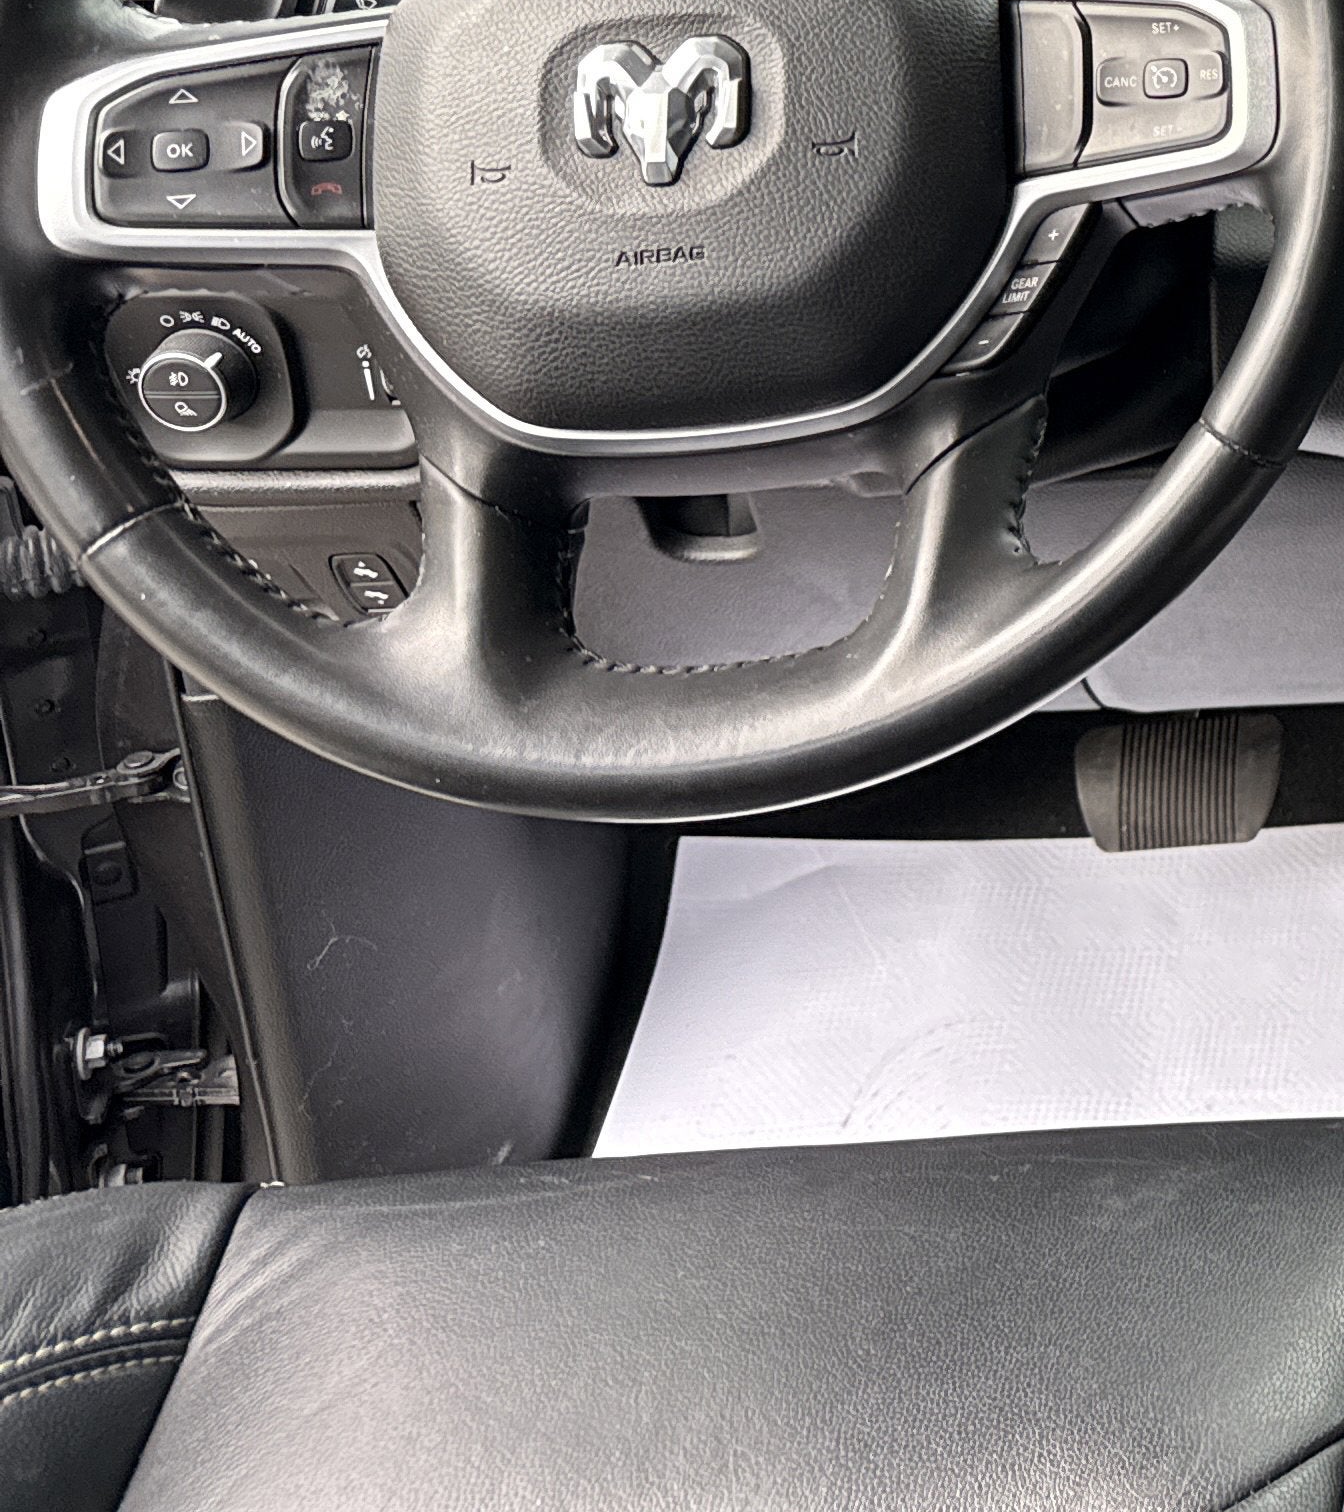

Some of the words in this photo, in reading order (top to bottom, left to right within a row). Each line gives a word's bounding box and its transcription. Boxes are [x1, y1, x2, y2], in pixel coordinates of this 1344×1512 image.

[1199, 69, 1218, 80] RES
[1105, 75, 1138, 89] CANC
[166, 142, 194, 159] OK
[615, 245, 706, 269] AIRBAG
[1011, 276, 1039, 290] GEAR
[1002, 290, 1030, 304] LIMIT
[231, 328, 262, 355] AUTO
